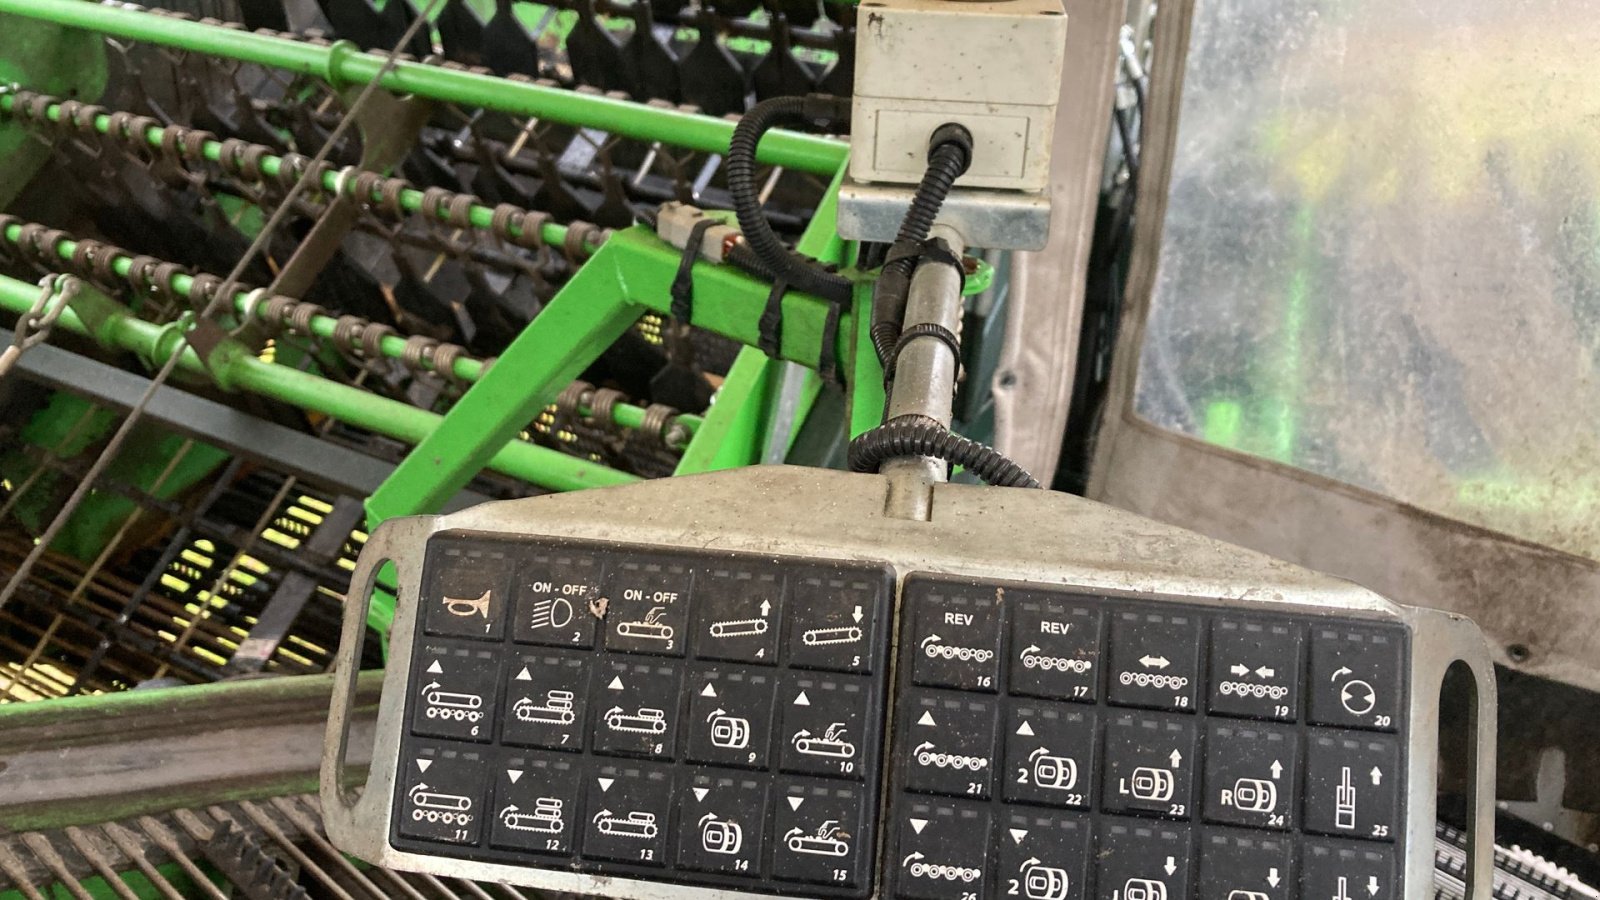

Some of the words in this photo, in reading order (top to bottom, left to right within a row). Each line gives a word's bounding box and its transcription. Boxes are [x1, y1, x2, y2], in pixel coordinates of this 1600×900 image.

[944, 612, 974, 626] REV
[485, 623, 491, 633] 1
[1040, 620, 1070, 635] REV
[572, 631, 581, 642] 2
[665, 639, 674, 650] 3
[755, 647, 765, 659] 4
[851, 655, 861, 667] 5
[977, 675, 991, 688] 16
[1073, 685, 1089, 697] 17
[1174, 695, 1189, 708] 18
[1274, 705, 1289, 717] 19
[1374, 714, 1391, 727] 20
[470, 725, 479, 736] 6
[560, 734, 570, 745] 7
[654, 743, 663, 754] 8
[748, 752, 757, 763] 9
[840, 761, 854, 773] 10
[1016, 767, 1029, 784] 2
[966, 782, 983, 795] 21
[1119, 777, 1130, 795] L
[1065, 793, 1083, 806] 22
[1220, 789, 1236, 806] R
[1169, 803, 1186, 816] 23
[1267, 813, 1284, 827] 24
[455, 829, 468, 841] 11
[1371, 824, 1389, 837] 25
[546, 839, 560, 851] 12
[640, 848, 654, 861] 13
[735, 859, 749, 871] 14
[833, 868, 848, 881] 15
[1007, 878, 1020, 895] 2
